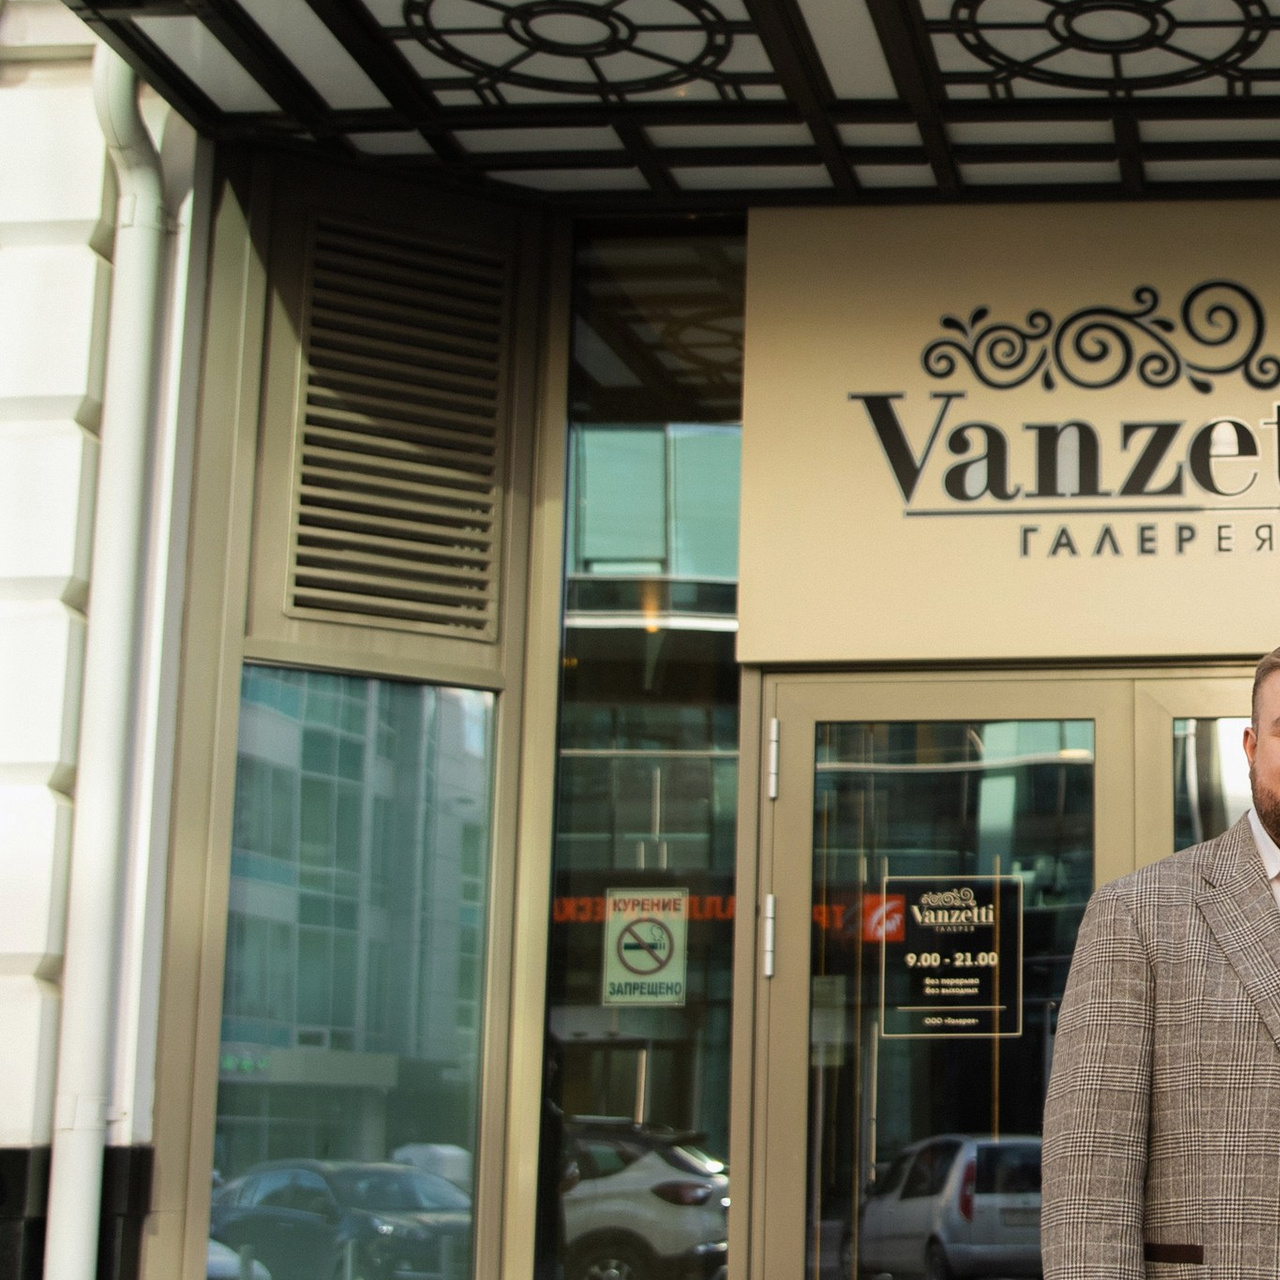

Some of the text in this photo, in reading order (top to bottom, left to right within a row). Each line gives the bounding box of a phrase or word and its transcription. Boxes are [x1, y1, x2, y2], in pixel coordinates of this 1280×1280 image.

[1019, 522, 1278, 558] ГАЛЕРЕЯ
[612, 897, 682, 912] КУРЕНИЕ
[911, 904, 994, 923] Vanzetti
[905, 952, 941, 967] 9.00
[954, 952, 998, 967] 21.00
[924, 977, 940, 985] без
[608, 981, 682, 998] ЗАПРЕЩЕНО
[924, 986, 979, 995] без выходных
[924, 1017, 943, 1025] ООО
